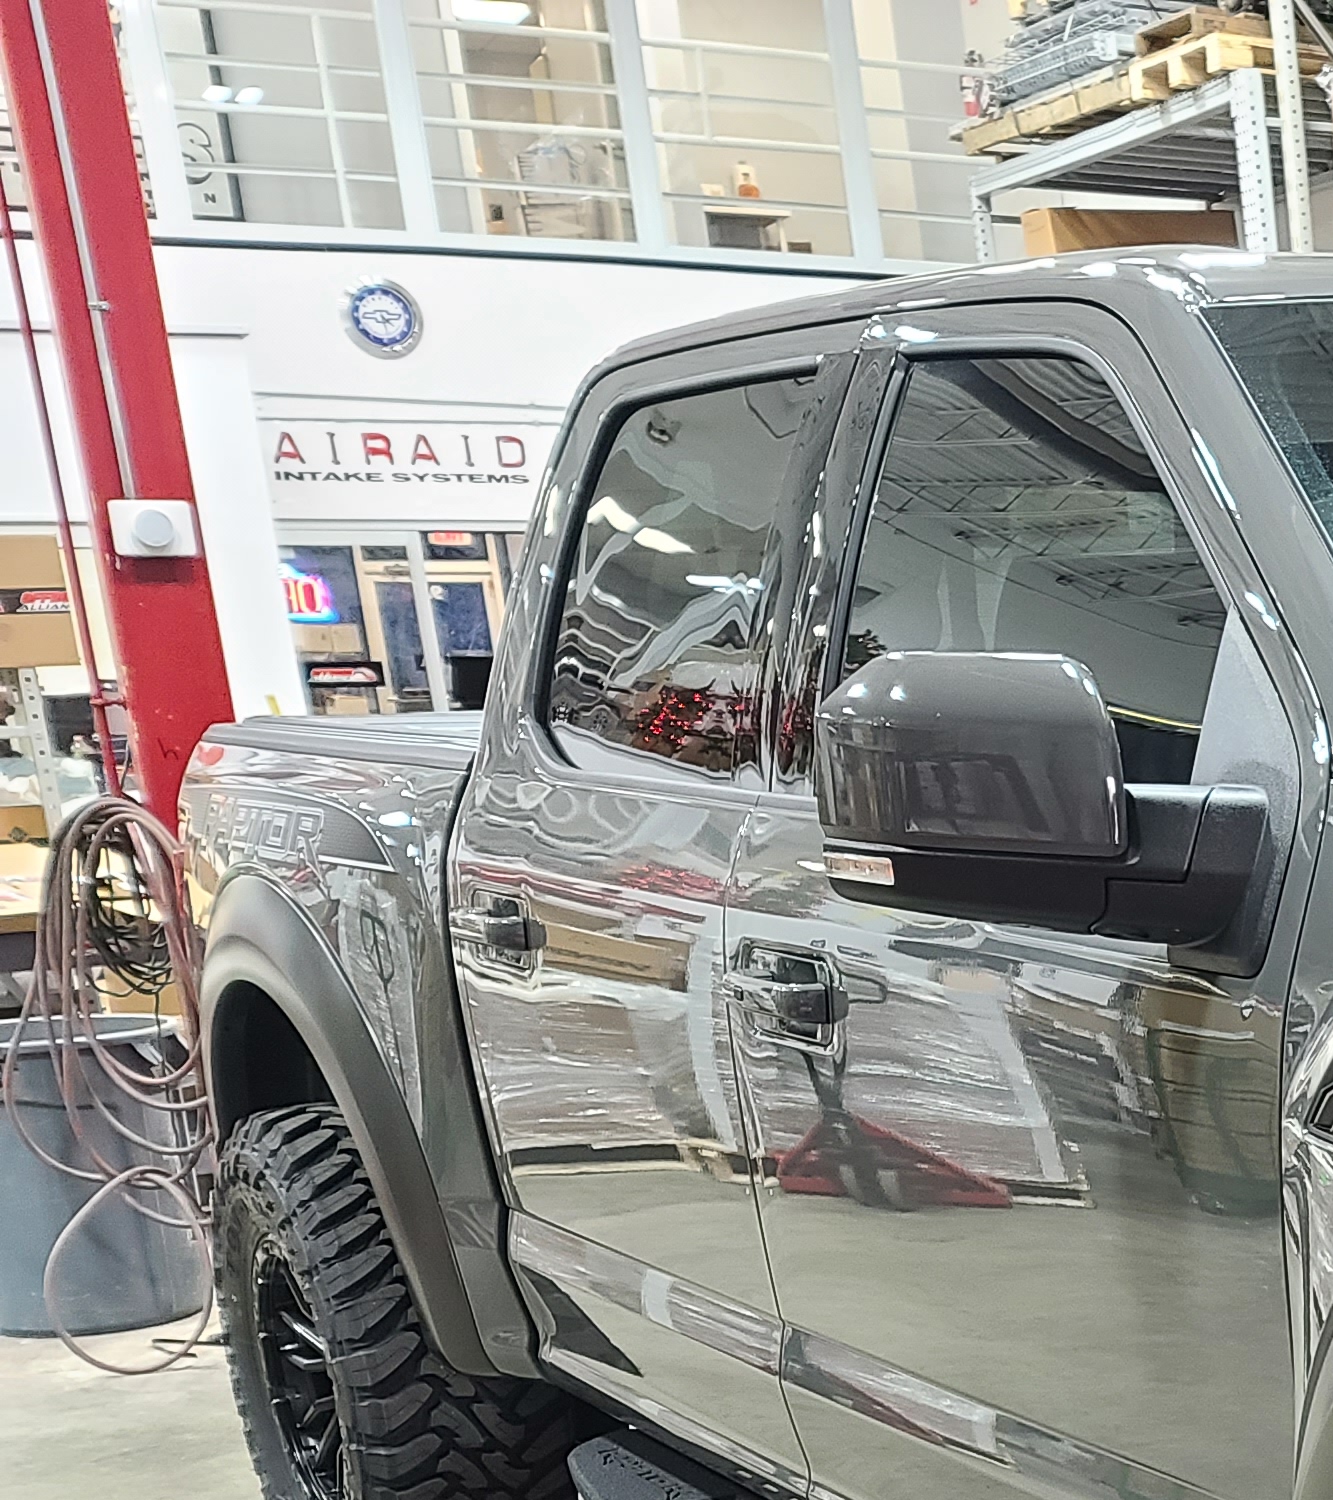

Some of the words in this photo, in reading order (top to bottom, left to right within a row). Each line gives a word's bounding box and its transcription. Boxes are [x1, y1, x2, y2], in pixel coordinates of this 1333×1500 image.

[273, 431, 526, 468] AIRAID
[274, 470, 385, 483] INTAKE
[392, 473, 530, 485] SYSTEMS
